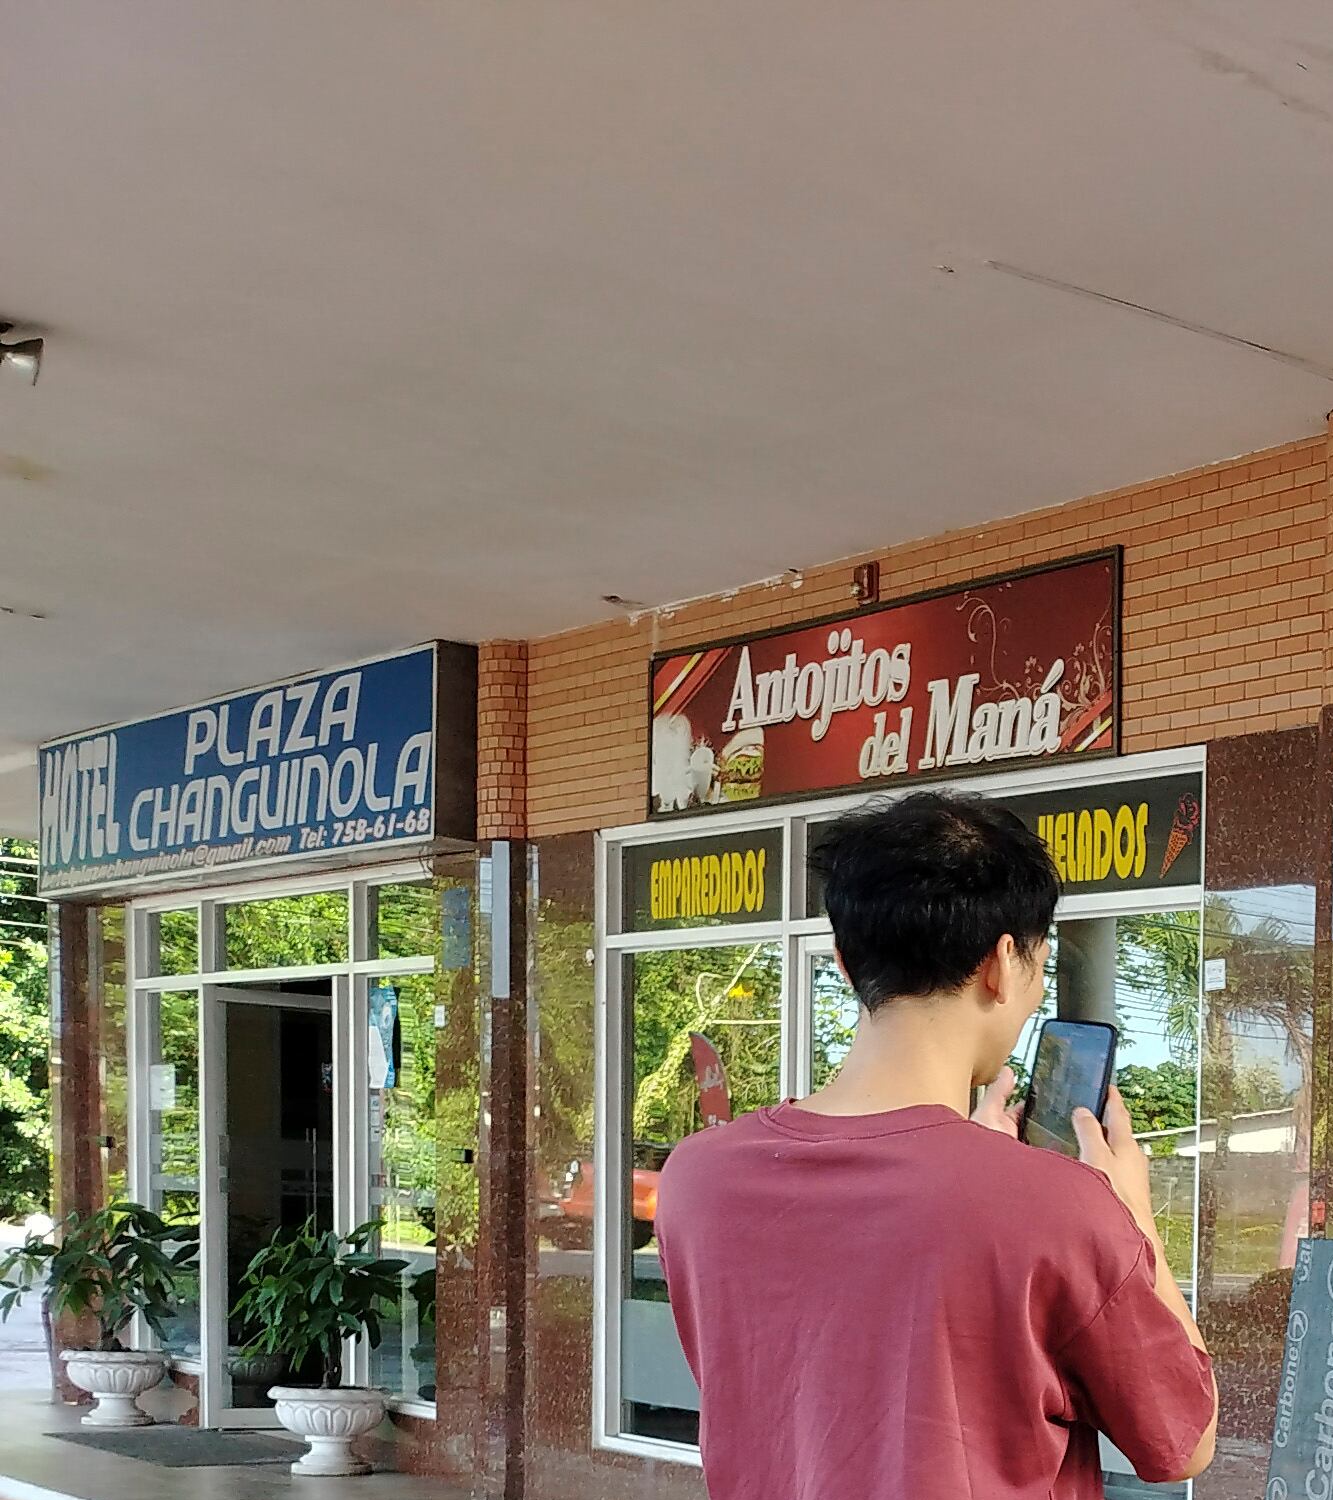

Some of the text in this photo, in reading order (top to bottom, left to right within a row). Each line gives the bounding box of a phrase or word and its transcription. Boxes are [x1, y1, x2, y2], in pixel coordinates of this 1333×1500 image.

[184, 671, 362, 776] PLAZA
[721, 627, 911, 741] Antojitos
[859, 658, 1065, 778] del Maná
[41, 731, 433, 867] HOTEL CHANGUINOLA
[300, 826, 326, 851] Tel:
[331, 808, 430, 843] 758-61-68
[1038, 801, 1149, 883] HELADOS
[650, 847, 766, 920] EMPAREDADOS
[1274, 1346, 1299, 1448] Carbone
